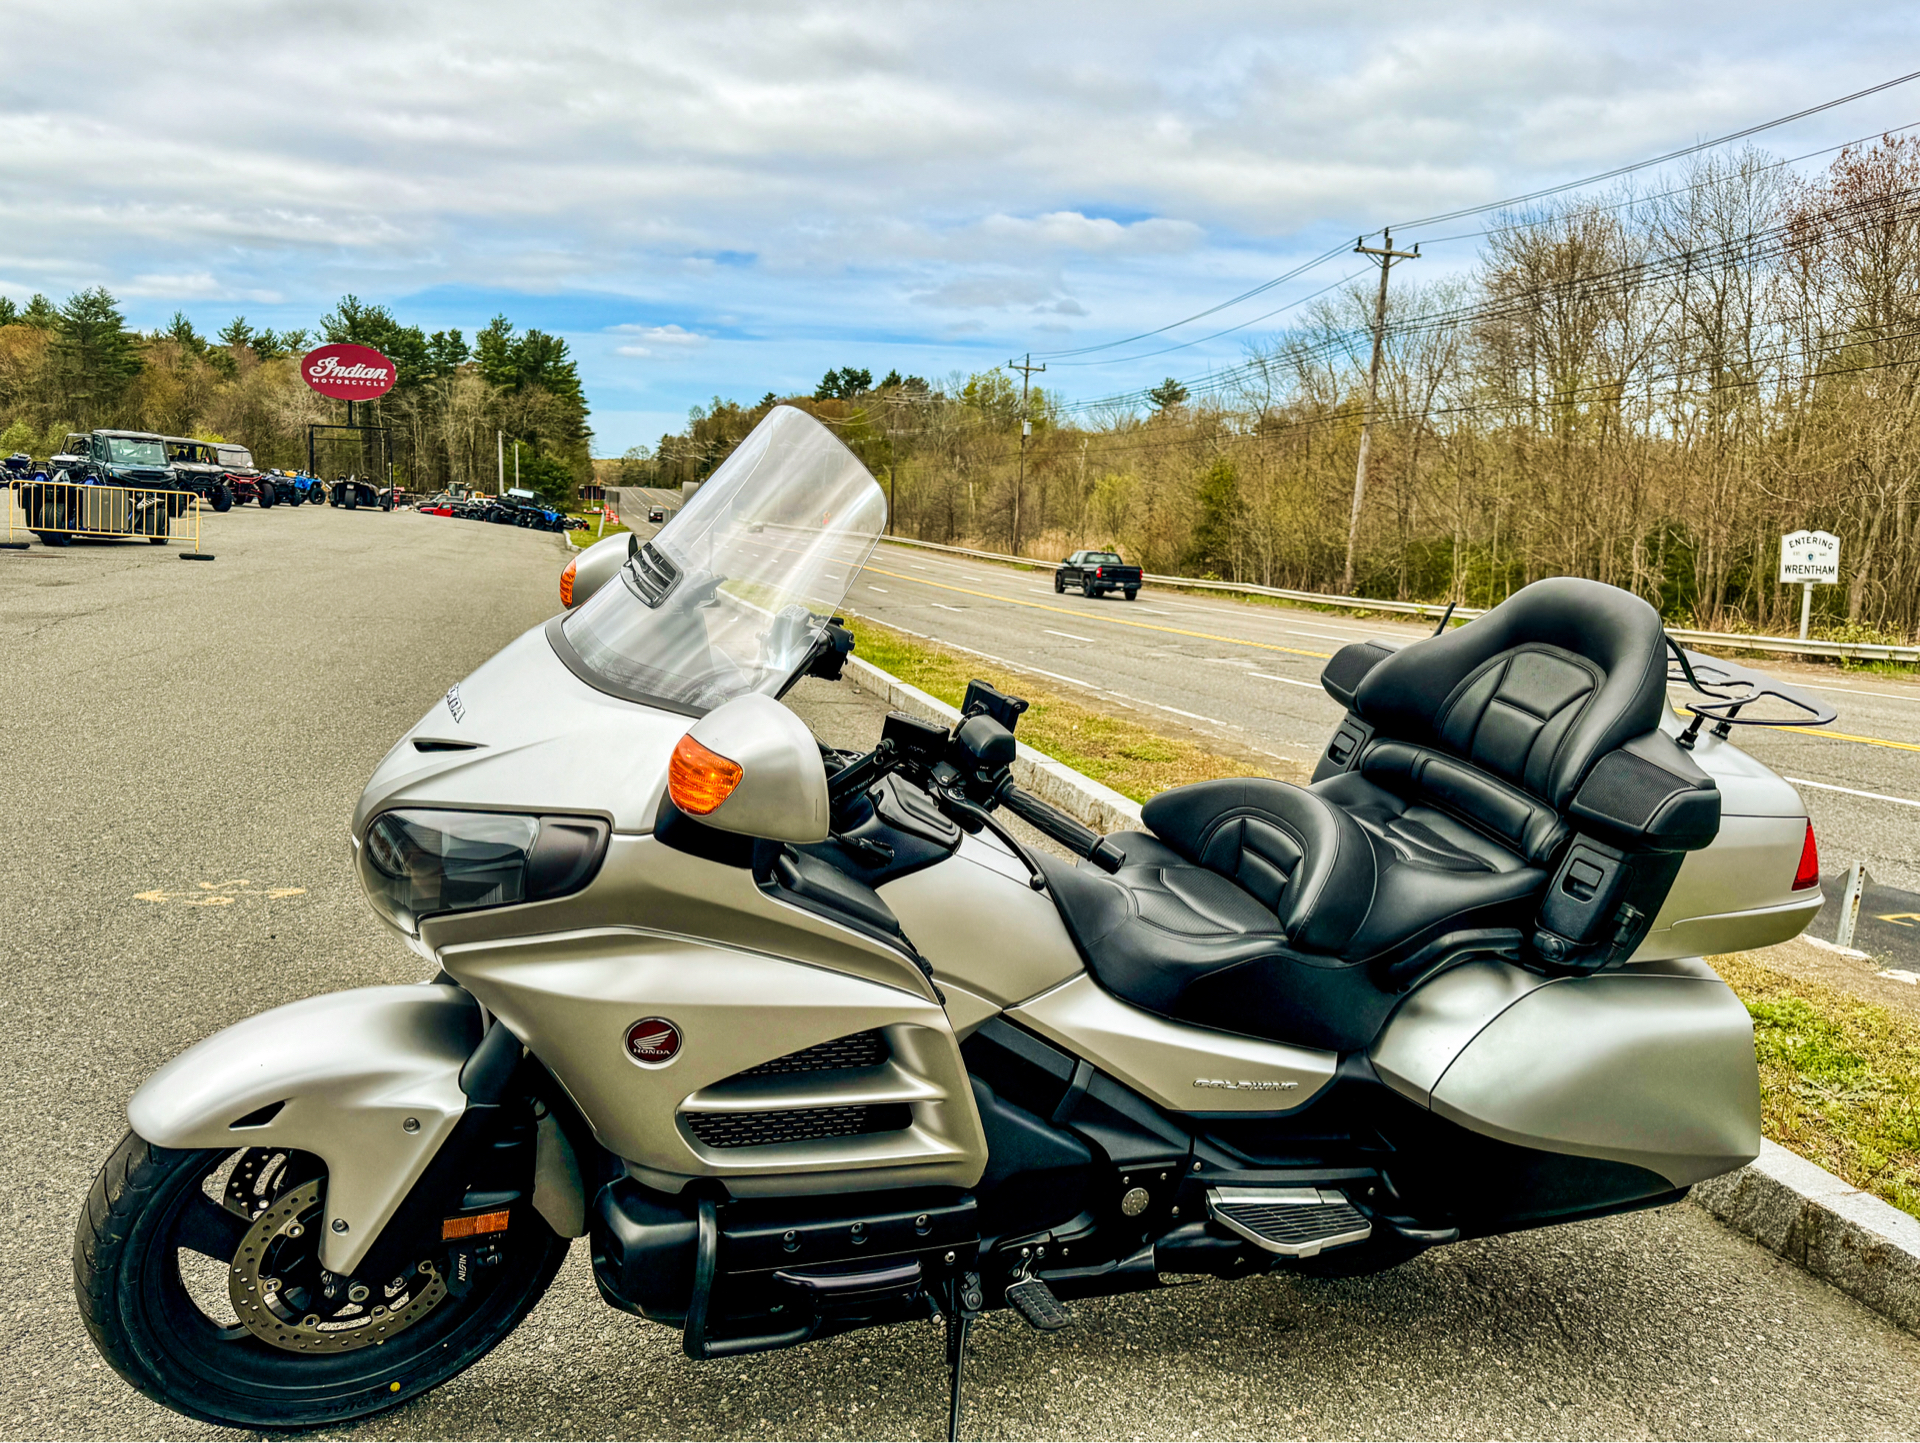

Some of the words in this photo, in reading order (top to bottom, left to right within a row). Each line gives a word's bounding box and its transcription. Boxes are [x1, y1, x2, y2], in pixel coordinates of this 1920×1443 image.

[309, 357, 387, 379] Indian
[312, 377, 386, 387] MOTORCYCLE
[1789, 536, 1833, 550] ENTERING
[1784, 564, 1835, 575] WRENTHAM
[633, 1047, 671, 1055] HONDA
[1193, 1078, 1299, 1091] GOLDWING
[458, 1253, 467, 1282] NISSIN
